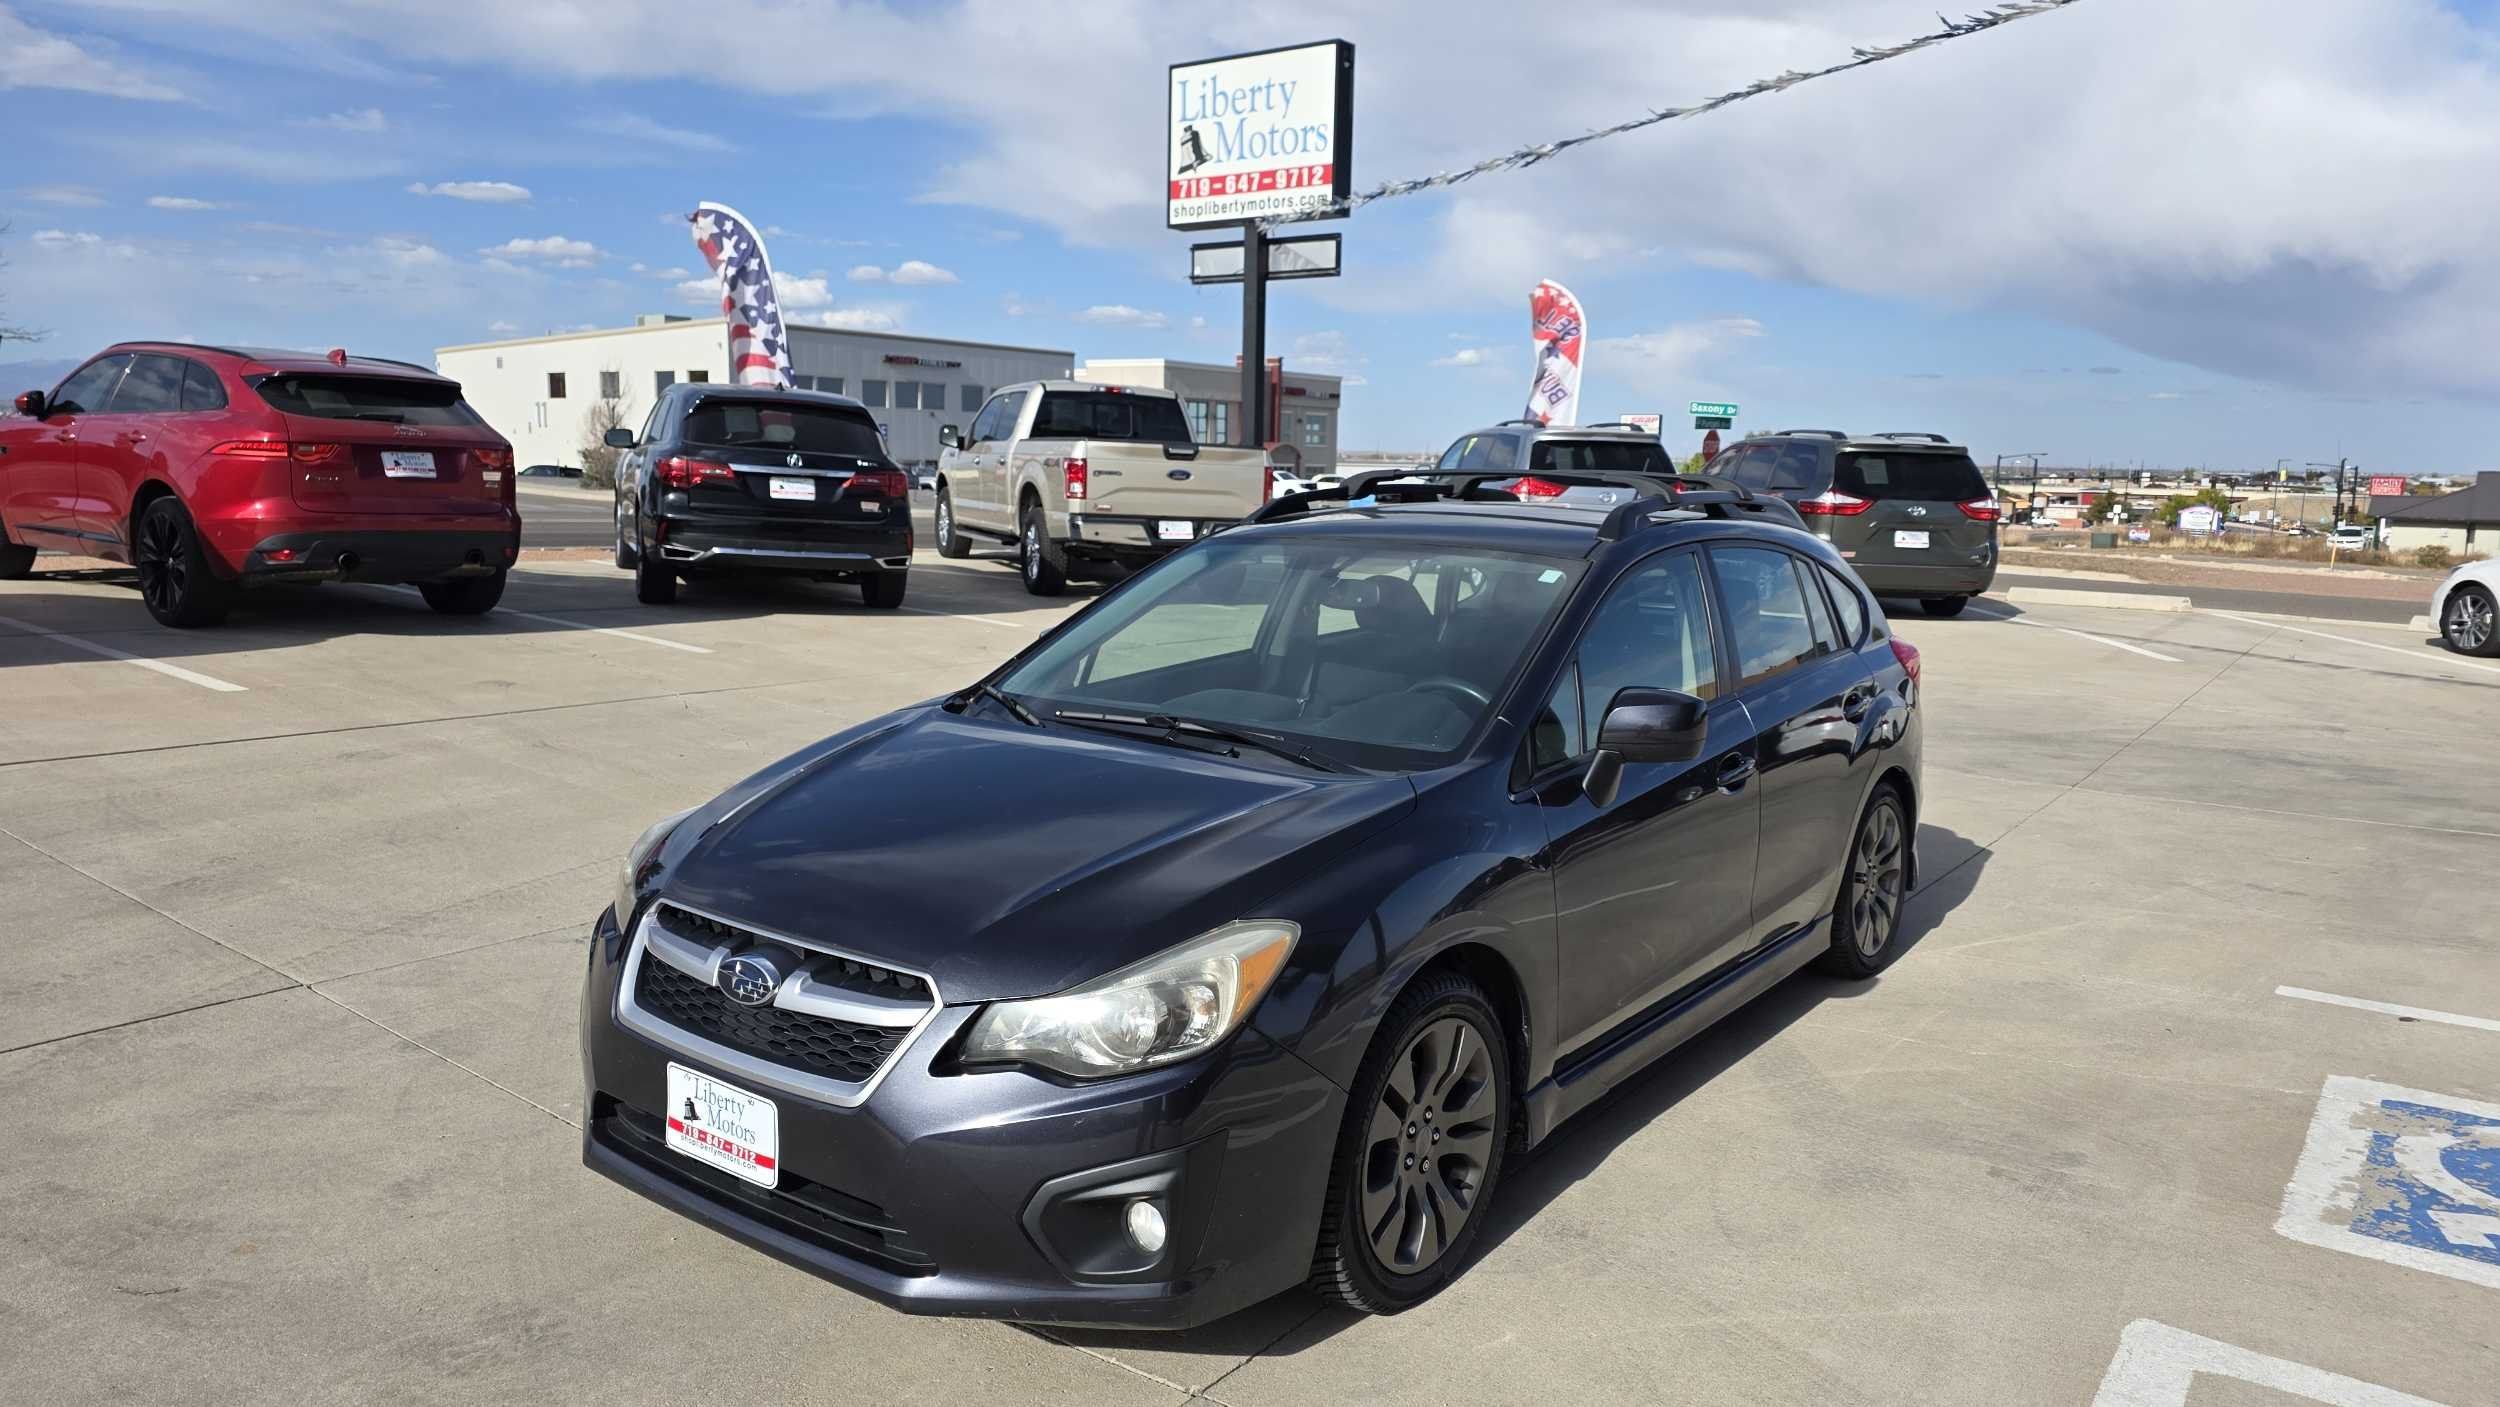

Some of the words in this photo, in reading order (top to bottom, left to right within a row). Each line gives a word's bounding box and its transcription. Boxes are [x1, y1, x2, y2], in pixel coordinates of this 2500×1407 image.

[1178, 75, 1297, 122] Liberty
[1214, 117, 1329, 164] Motors
[1179, 165, 1325, 198] 719-647-9712
[1691, 402, 1726, 415] Saxony
[1727, 406, 1737, 415] Dr
[693, 1077, 745, 1122] Liberty
[682, 1123, 757, 1162] 719-647-9712
[707, 1104, 756, 1144] Motors
